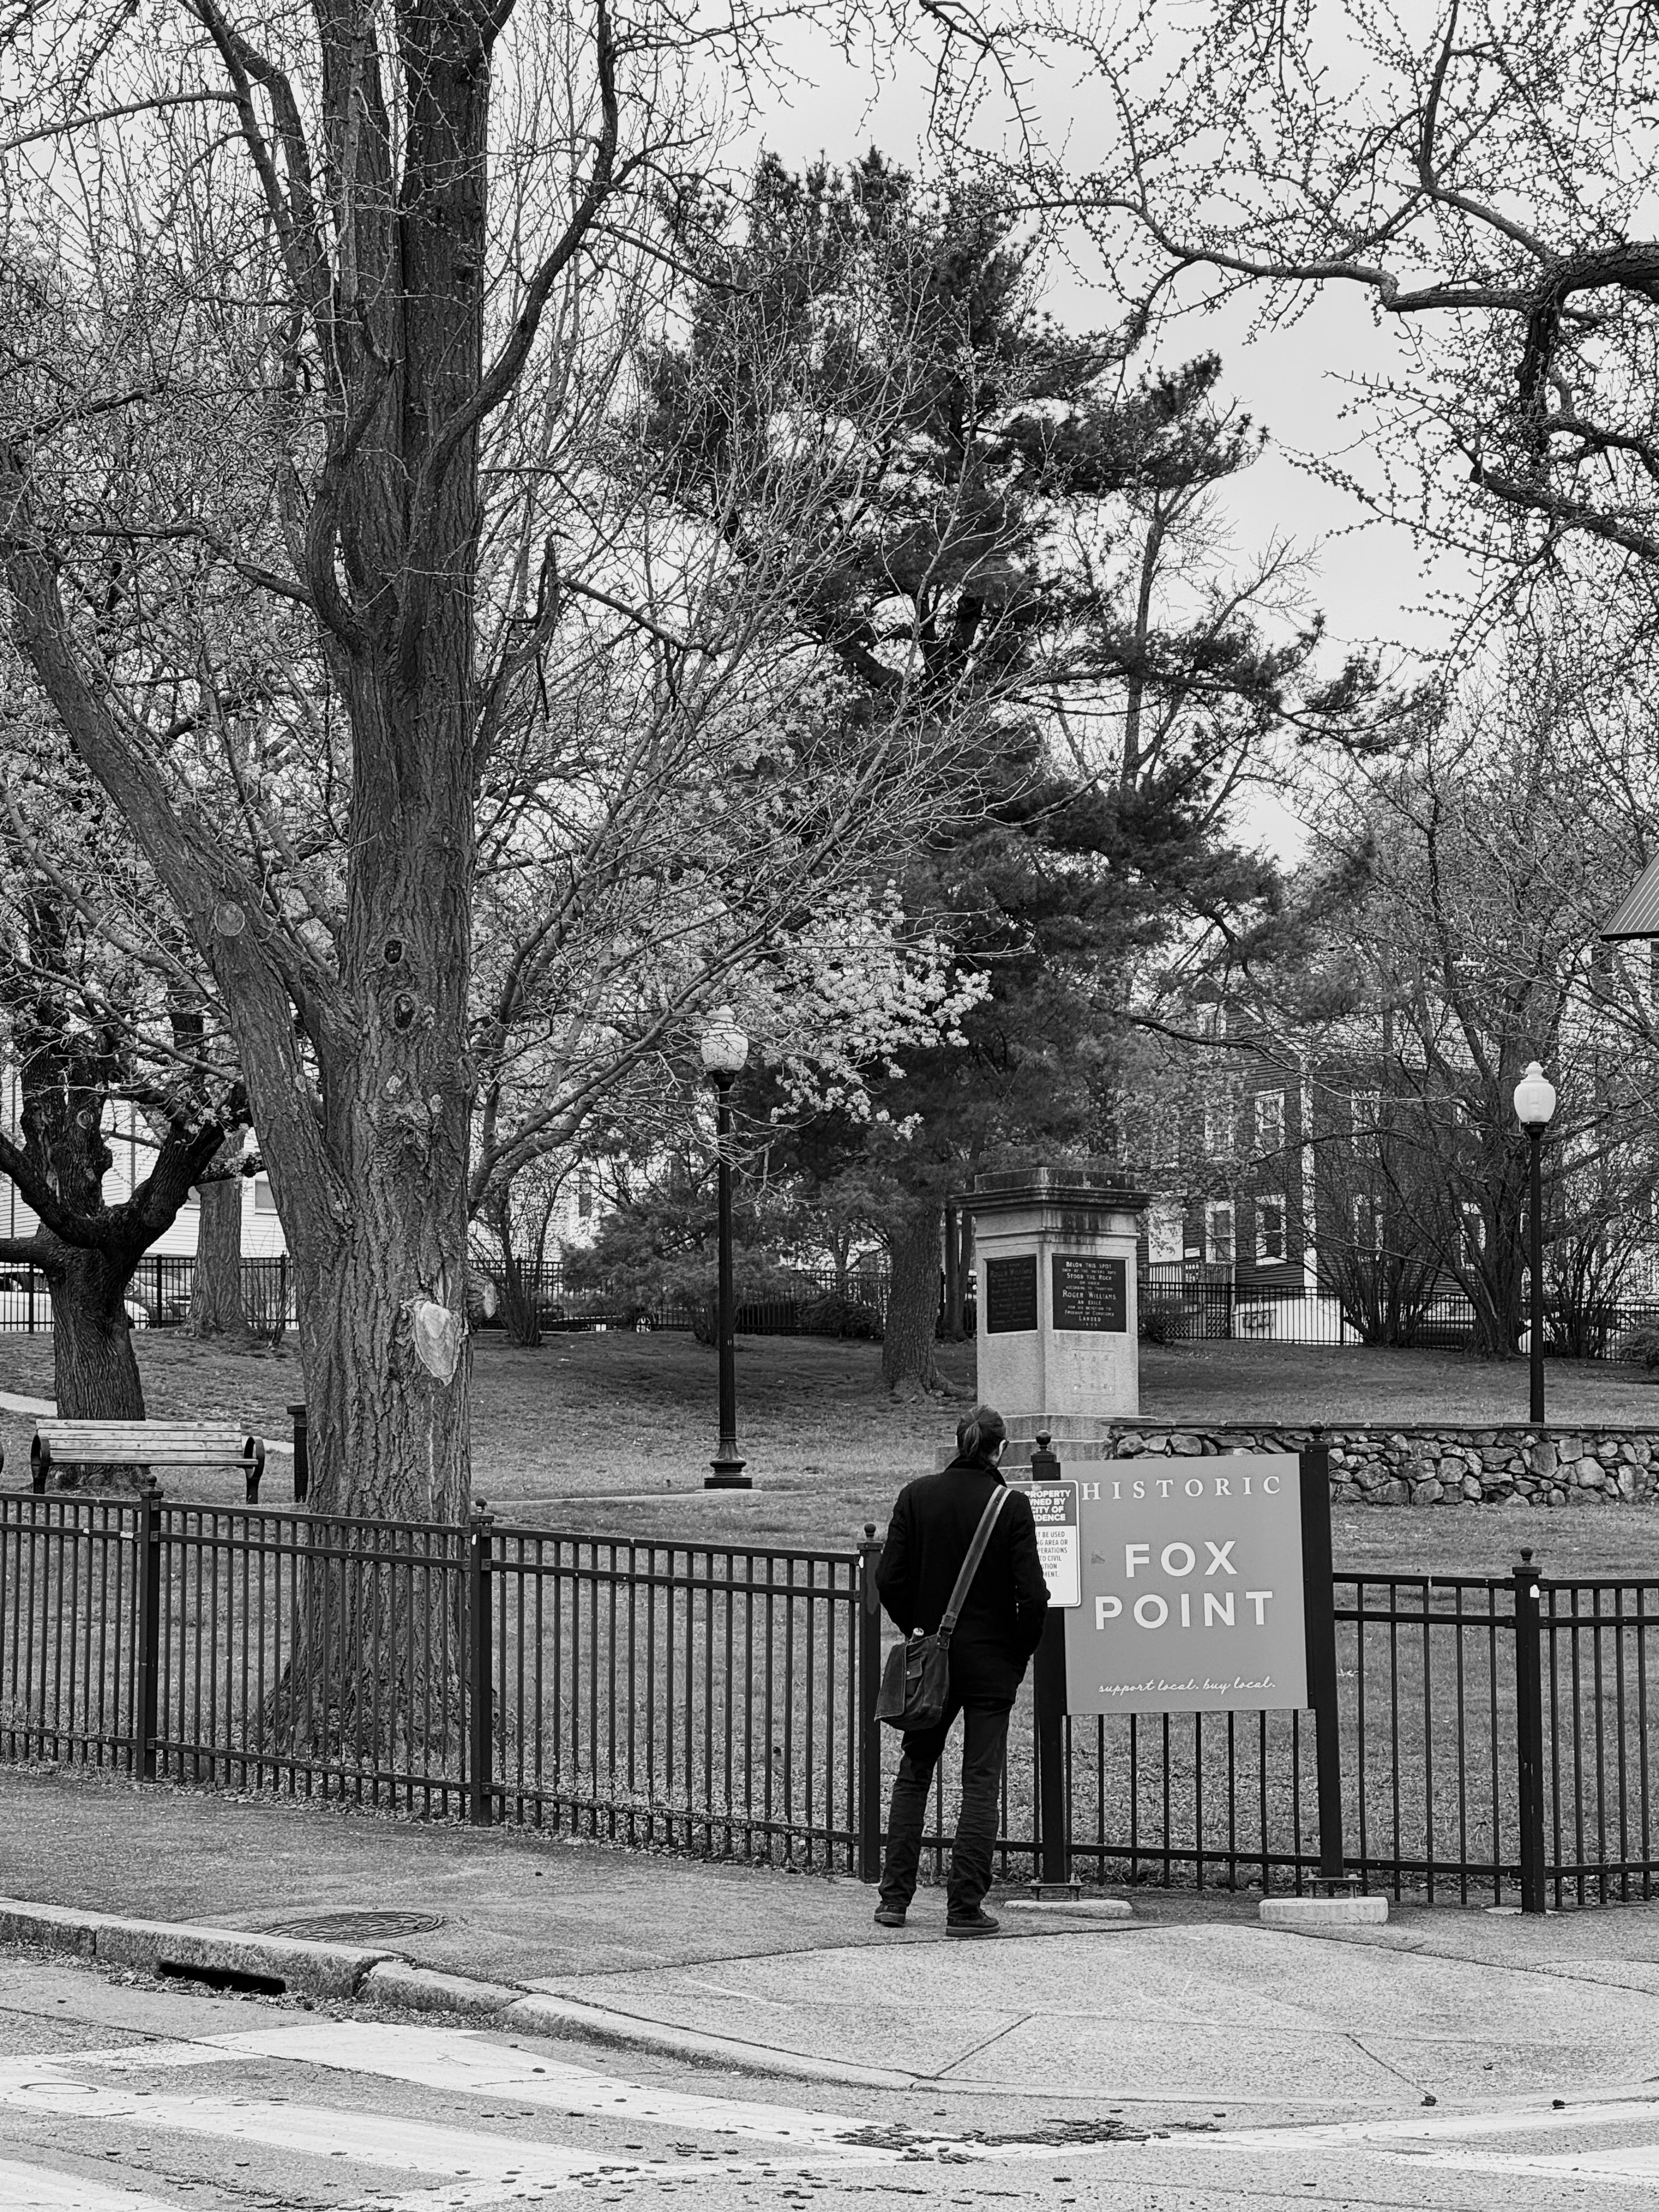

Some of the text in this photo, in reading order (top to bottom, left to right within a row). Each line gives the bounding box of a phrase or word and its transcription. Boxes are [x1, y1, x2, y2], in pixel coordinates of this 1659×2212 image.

[1063, 1289, 1116, 1300] ROGER WILLIAMS
[1024, 1489, 1071, 1498] PROPERTY
[1082, 1476, 1280, 1500] HISTORIC
[1033, 1514, 1066, 1522] IDENCE
[1126, 1541, 1238, 1578] FOX
[1096, 1591, 1273, 1630] POINT
[1099, 1676, 1276, 1696] support local. buy local.
